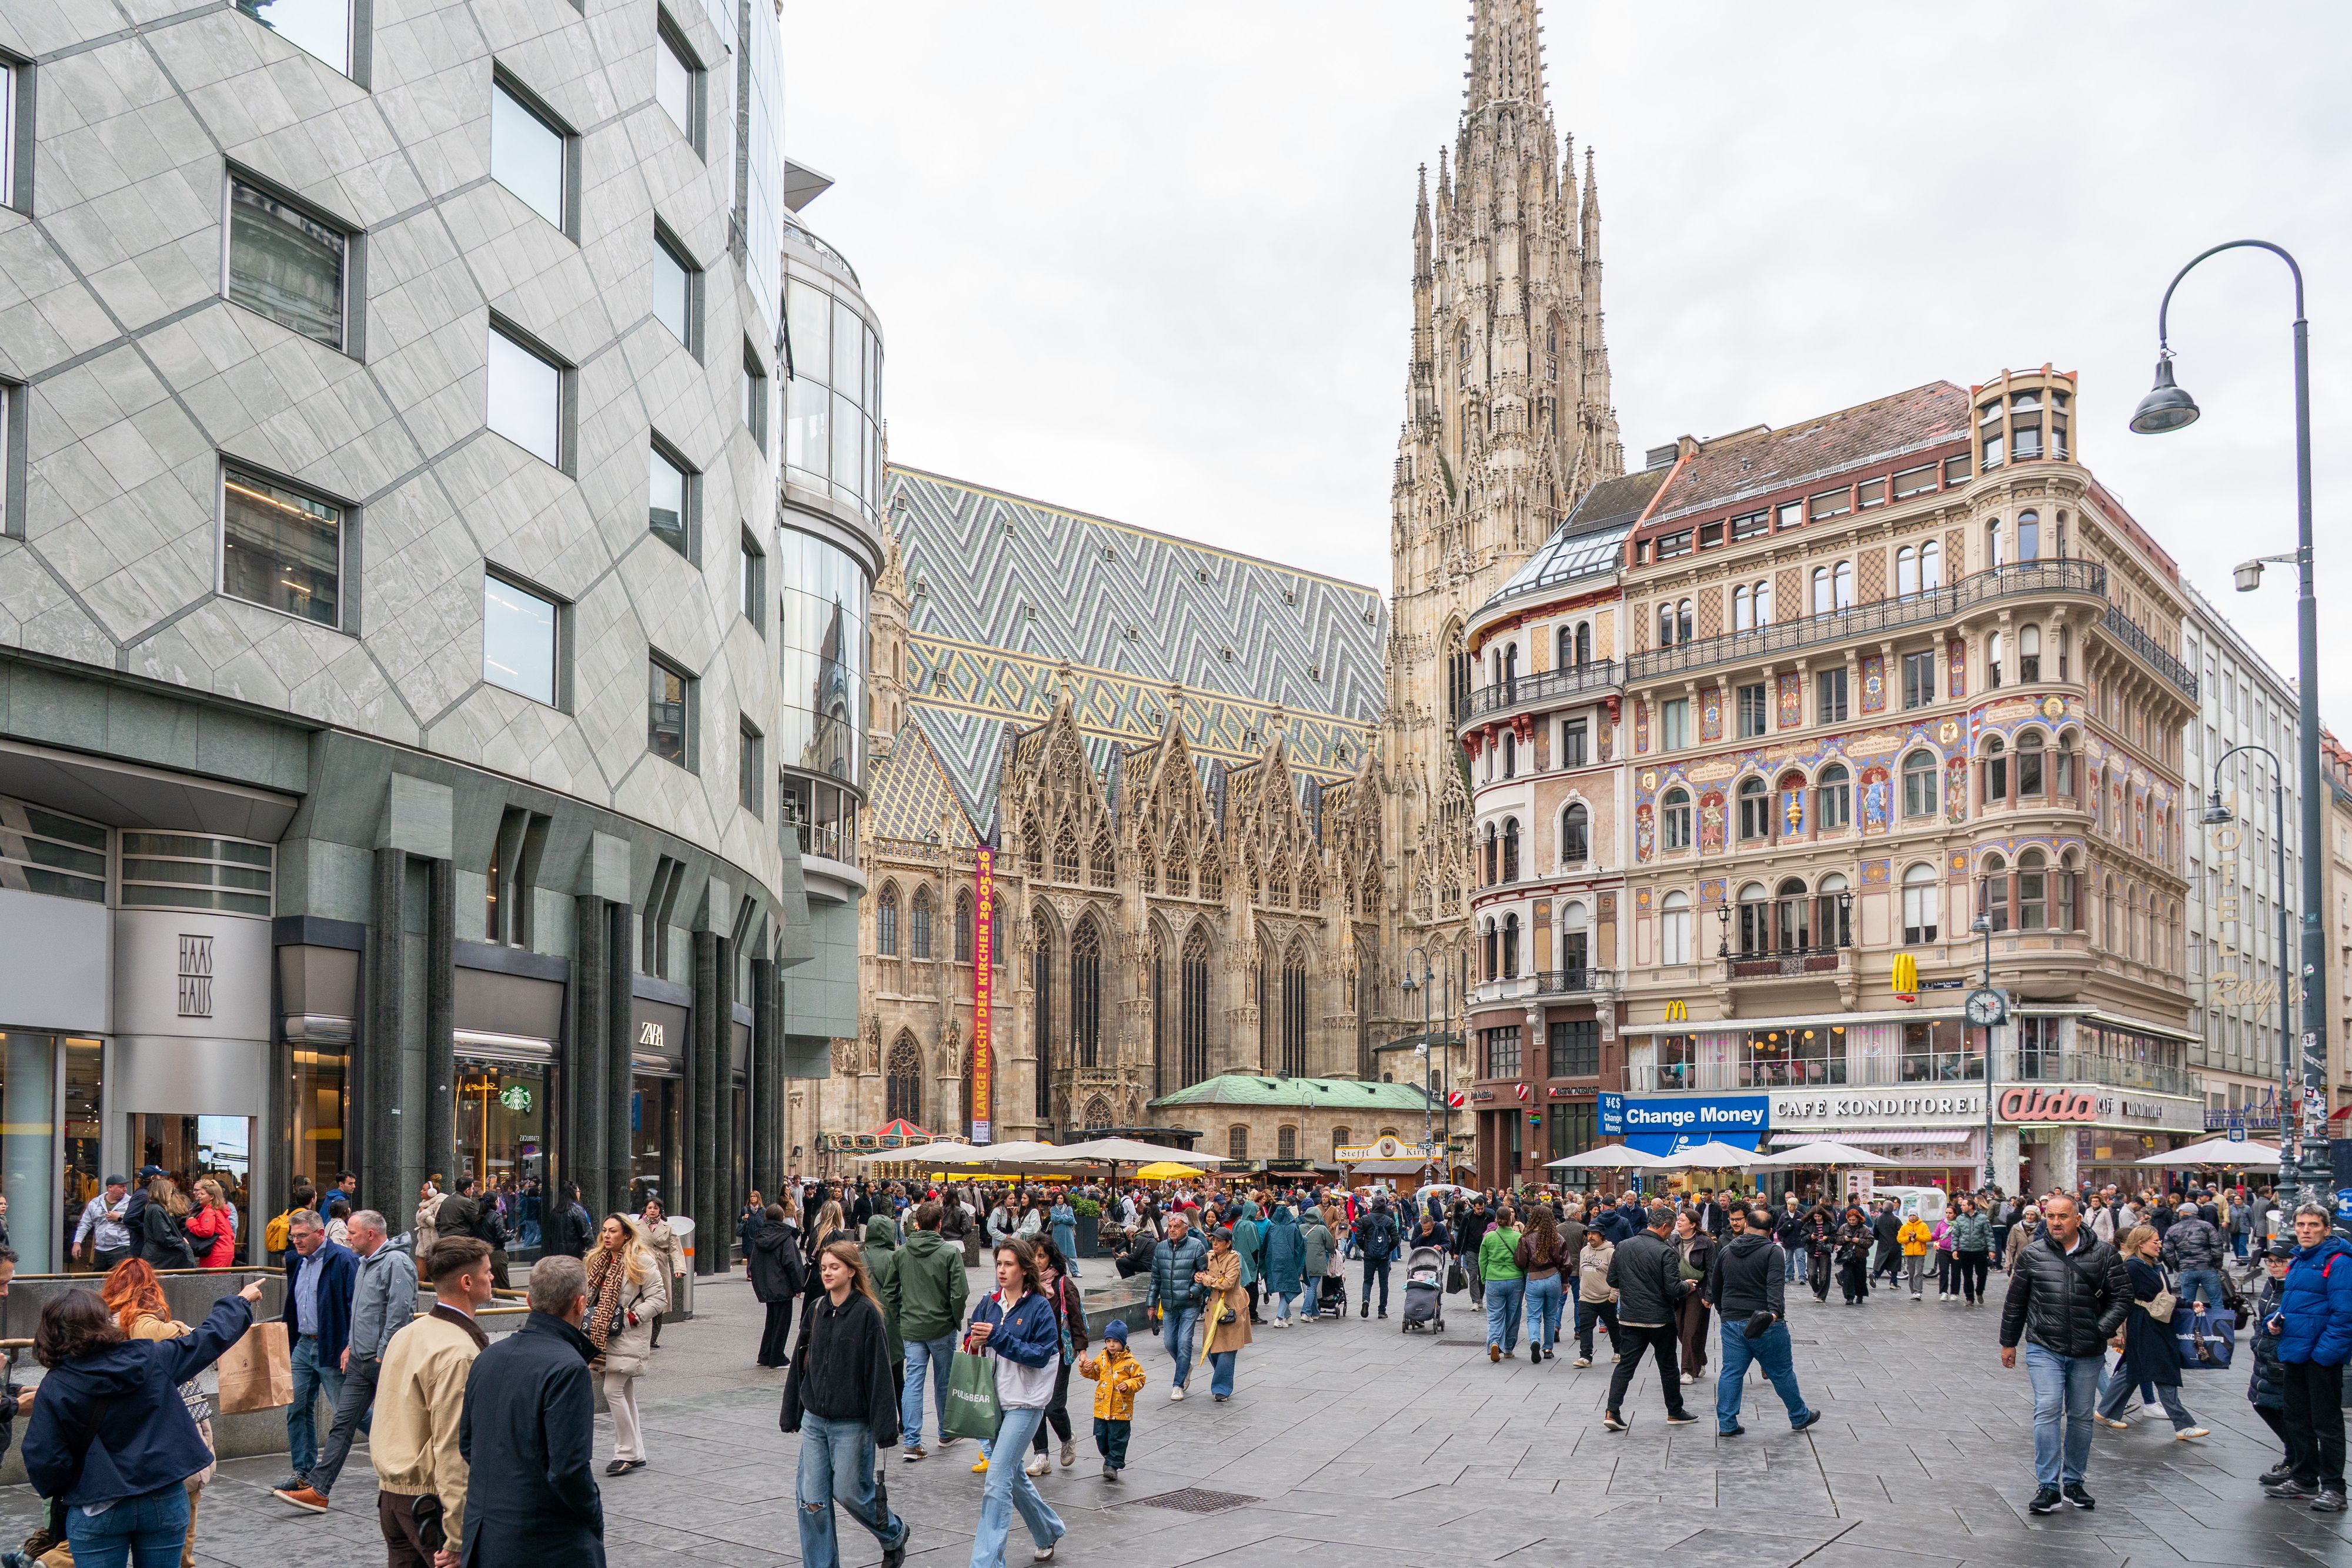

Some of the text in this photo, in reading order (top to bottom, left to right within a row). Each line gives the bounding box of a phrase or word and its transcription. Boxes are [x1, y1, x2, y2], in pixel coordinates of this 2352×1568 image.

[978, 851, 992, 921] 29.05.26
[179, 938, 213, 974] HAAS
[978, 925, 988, 985] KIRCHEN
[179, 978, 212, 1014] HAUS
[978, 990, 988, 1017] DER
[639, 1022, 664, 1047] ZARA
[977, 1021, 987, 1068] NACHT
[976, 1072, 986, 1117] LANGE
[1478, 1090, 1492, 1099] Austria
[1574, 1086, 1596, 1095] Austria
[1626, 1106, 1764, 1126] Change Money
[1775, 1097, 1977, 1116] CAFÉ KONDITOREI
[2126, 1101, 2164, 1118] KONDITOREI
[1604, 1112, 1622, 1123] Change
[2204, 1118, 2244, 1127] SETTIMO
[1605, 1123, 1621, 1134] Money
[1341, 1148, 1436, 1159] Steffl Kirtg
